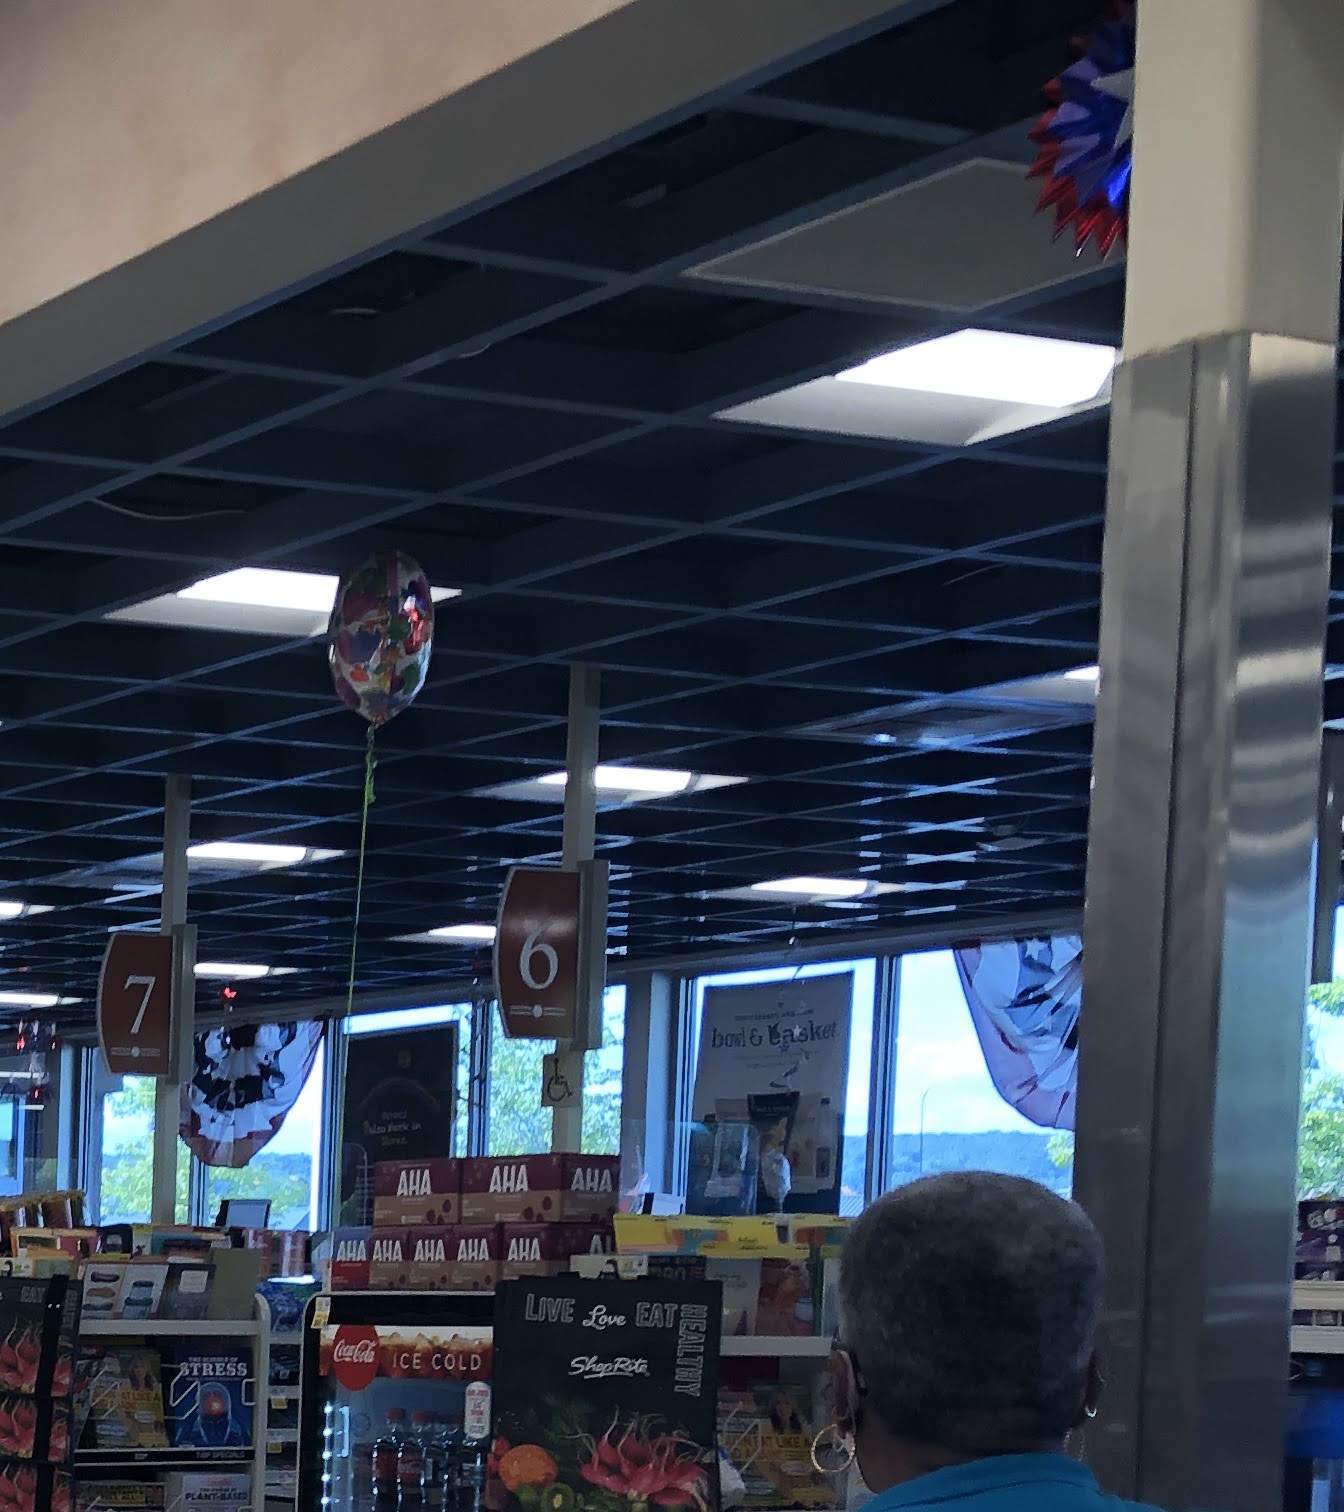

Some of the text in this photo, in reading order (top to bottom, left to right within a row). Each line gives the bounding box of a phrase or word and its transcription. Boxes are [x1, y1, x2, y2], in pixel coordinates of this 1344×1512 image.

[518, 920, 560, 991] 6
[123, 974, 157, 1050] 7
[396, 1168, 432, 1197] AHA
[489, 1164, 529, 1193] AHA
[570, 1167, 613, 1193] AHA
[336, 1239, 366, 1262] AHA
[372, 1239, 403, 1262] AHA
[414, 1239, 446, 1262] AHA
[457, 1238, 489, 1262] AHA
[507, 1237, 541, 1262] AHA
[525, 1293, 678, 1330] LIVE Love EAT
[392, 1353, 481, 1371] ICE COLD
[674, 1303, 708, 1398] HEALTHY
[180, 1361, 248, 1377] STRESS
[568, 1355, 650, 1380] ShopRite
[185, 1491, 248, 1501] PLANT-BASED
